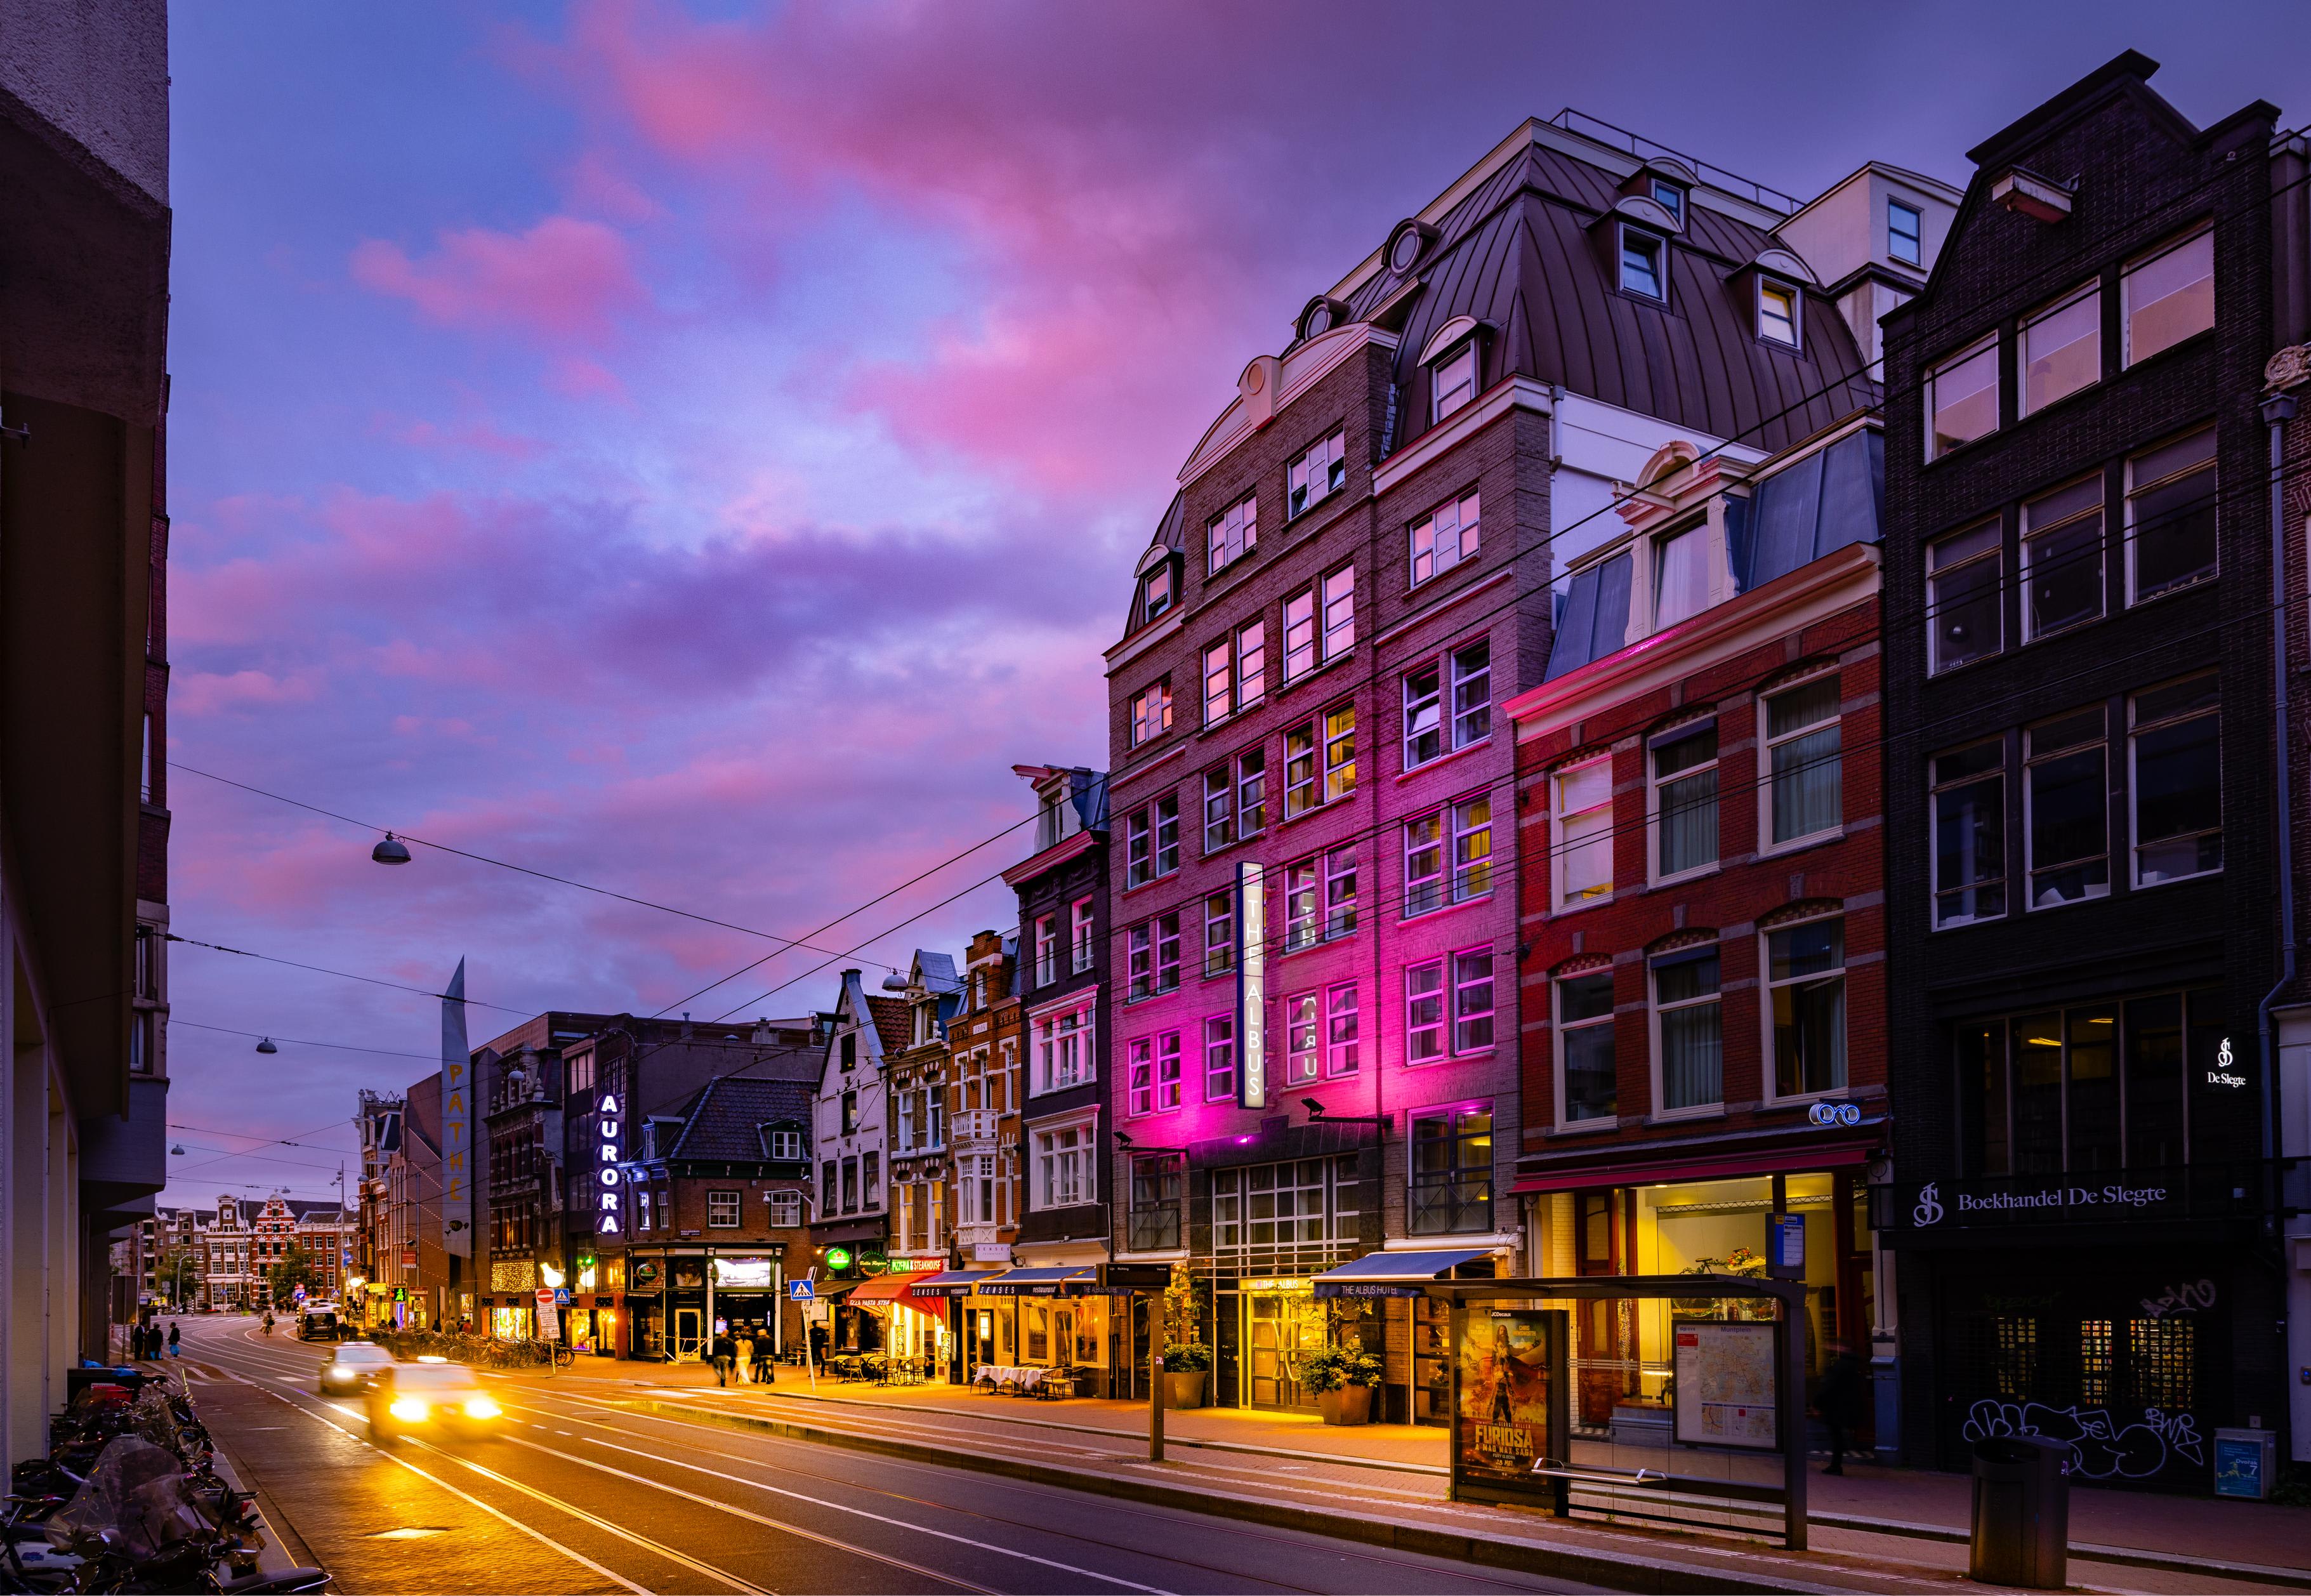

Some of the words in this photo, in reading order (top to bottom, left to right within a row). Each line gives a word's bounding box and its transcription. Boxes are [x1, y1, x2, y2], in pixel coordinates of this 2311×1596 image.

[1246, 899, 1260, 965] THE
[1245, 984, 1261, 1096] ALBUS
[2207, 1071, 2220, 1083] De
[2221, 1072, 2246, 1088] Slegte
[601, 1095, 618, 1232] AURORA
[1958, 1189, 2062, 1210] Boekhandel
[2069, 1187, 2098, 1205] De
[2102, 1185, 2166, 1207] Slegte
[860, 1267, 886, 1277] Restaurant
[892, 1260, 910, 1271] PIZZERIA
[914, 1260, 941, 1270] STEAKHOUSE
[1263, 1280, 1274, 1289] THE
[1277, 1279, 1298, 1289] ALBUS
[1341, 1285, 1355, 1295] THE
[1355, 1285, 1376, 1295] ALBUS
[1376, 1285, 1397, 1295] HOTEL
[1475, 1424, 1534, 1449] FURIOSA
[1482, 1444, 1496, 1453] MAD
[1499, 1446, 1513, 1454] MAX
[1515, 1448, 1534, 1457] SAGA
[2249, 1465, 2258, 1475] 7
